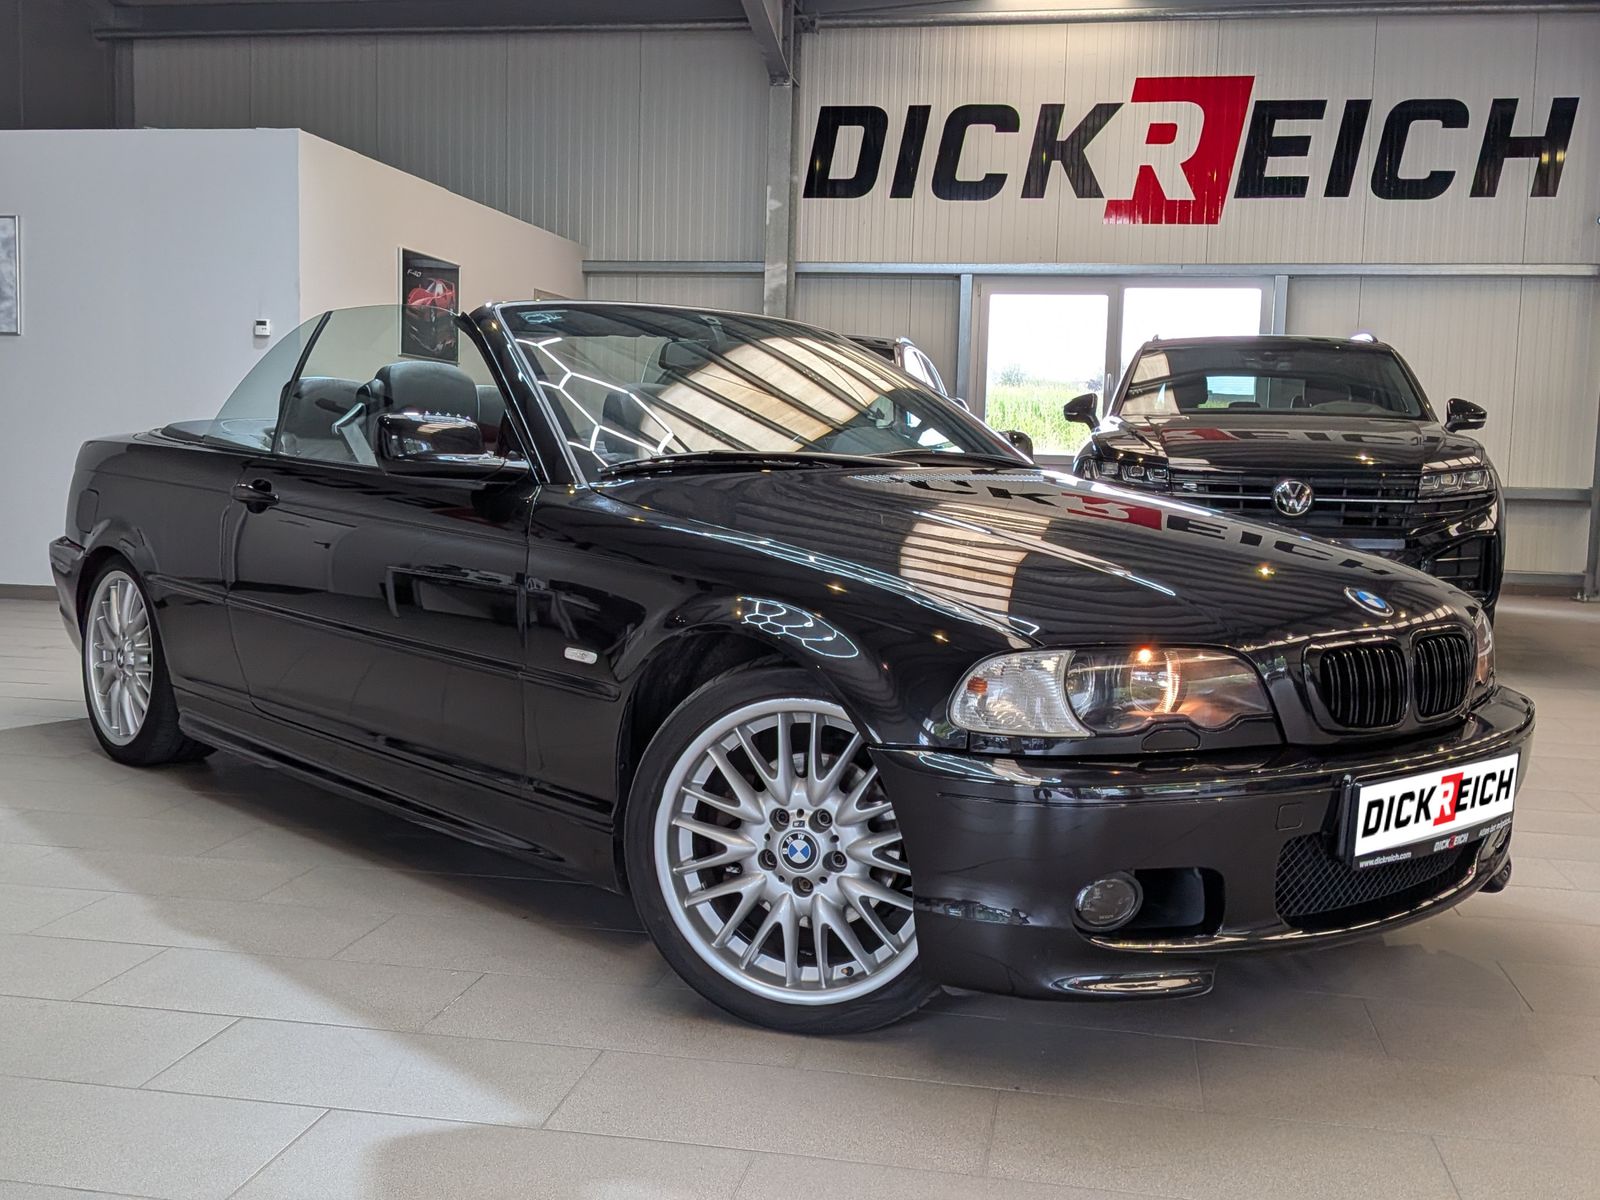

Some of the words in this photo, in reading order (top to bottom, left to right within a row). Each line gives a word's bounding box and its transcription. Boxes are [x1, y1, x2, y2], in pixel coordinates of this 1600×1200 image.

[803, 76, 1580, 224] DICKREICH
[1362, 767, 1514, 838] DICKREICH
[782, 832, 805, 855] BMW
[1433, 833, 1469, 853] DICKREICH
